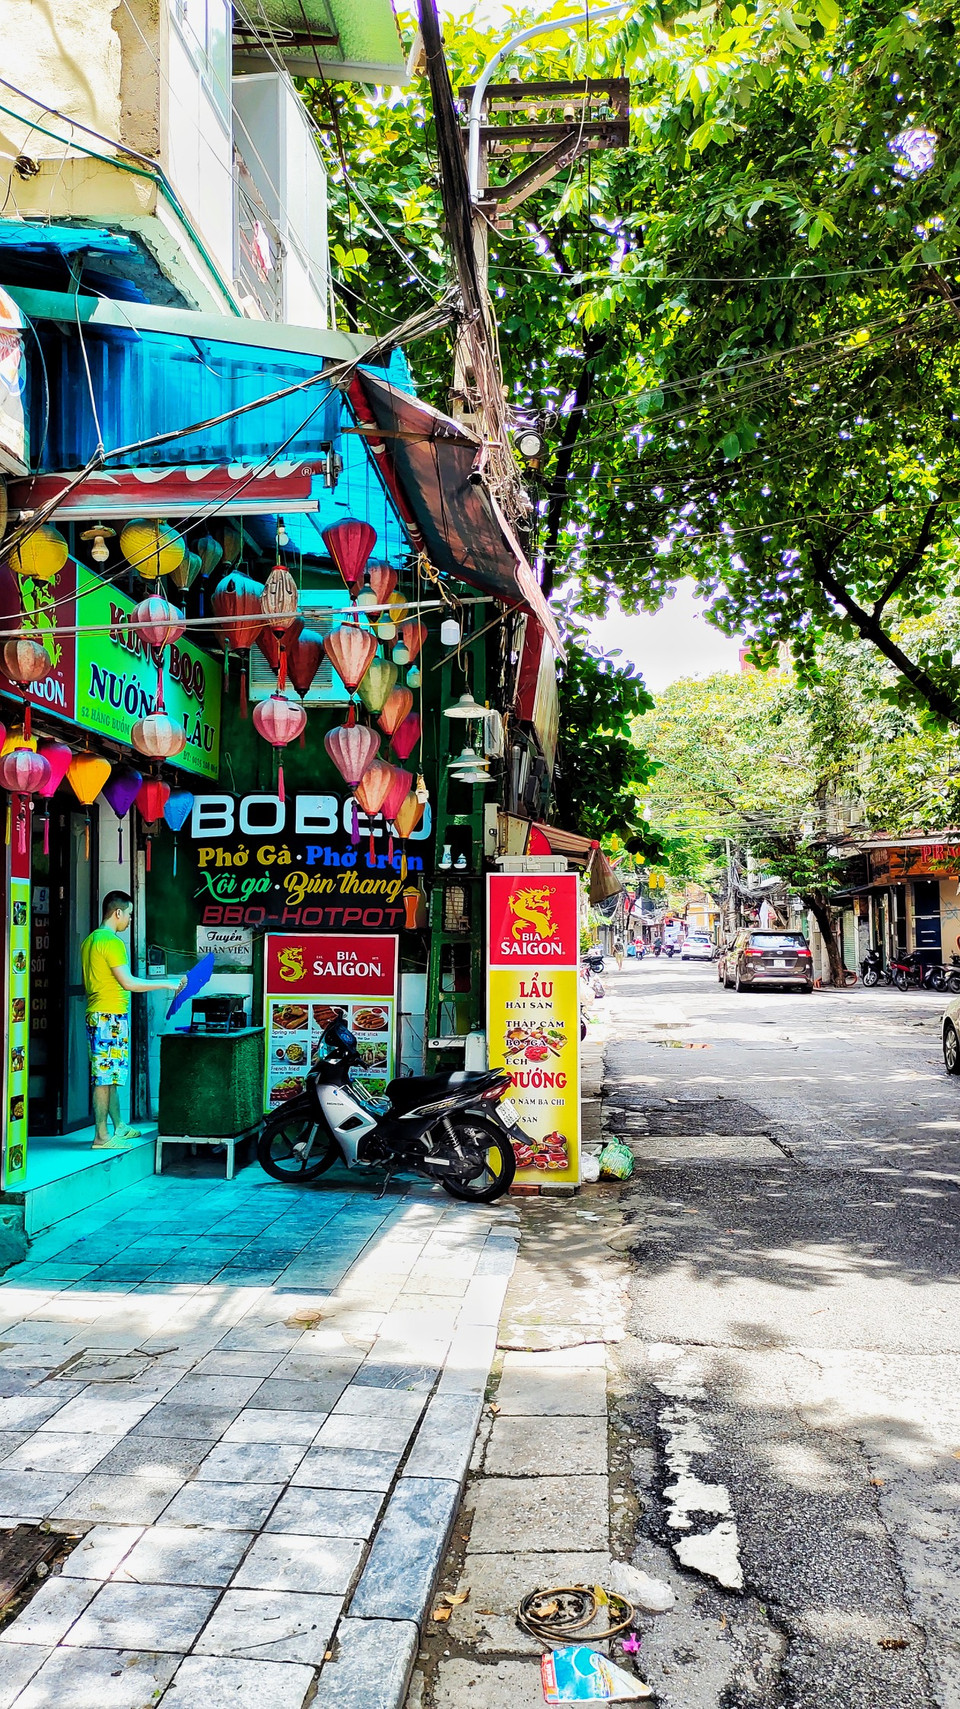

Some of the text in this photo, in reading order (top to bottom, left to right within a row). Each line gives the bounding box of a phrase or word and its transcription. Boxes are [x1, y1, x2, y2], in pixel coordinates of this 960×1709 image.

[197, 844, 249, 867] Phở
[257, 844, 292, 866] Gà
[305, 845, 358, 867] Phở
[194, 871, 239, 903] Xôi
[240, 871, 273, 902] gà
[283, 871, 336, 905] Bún
[207, 930, 243, 943] Tuyển
[522, 932, 541, 941] BIA
[199, 944, 250, 954] NHÂN VIÊN
[336, 951, 358, 960] BIA
[500, 941, 562, 955] SAIGON
[313, 961, 381, 977] SAIGON
[519, 971, 553, 998] LẨU
[505, 1067, 568, 1089] NƯỚNG
